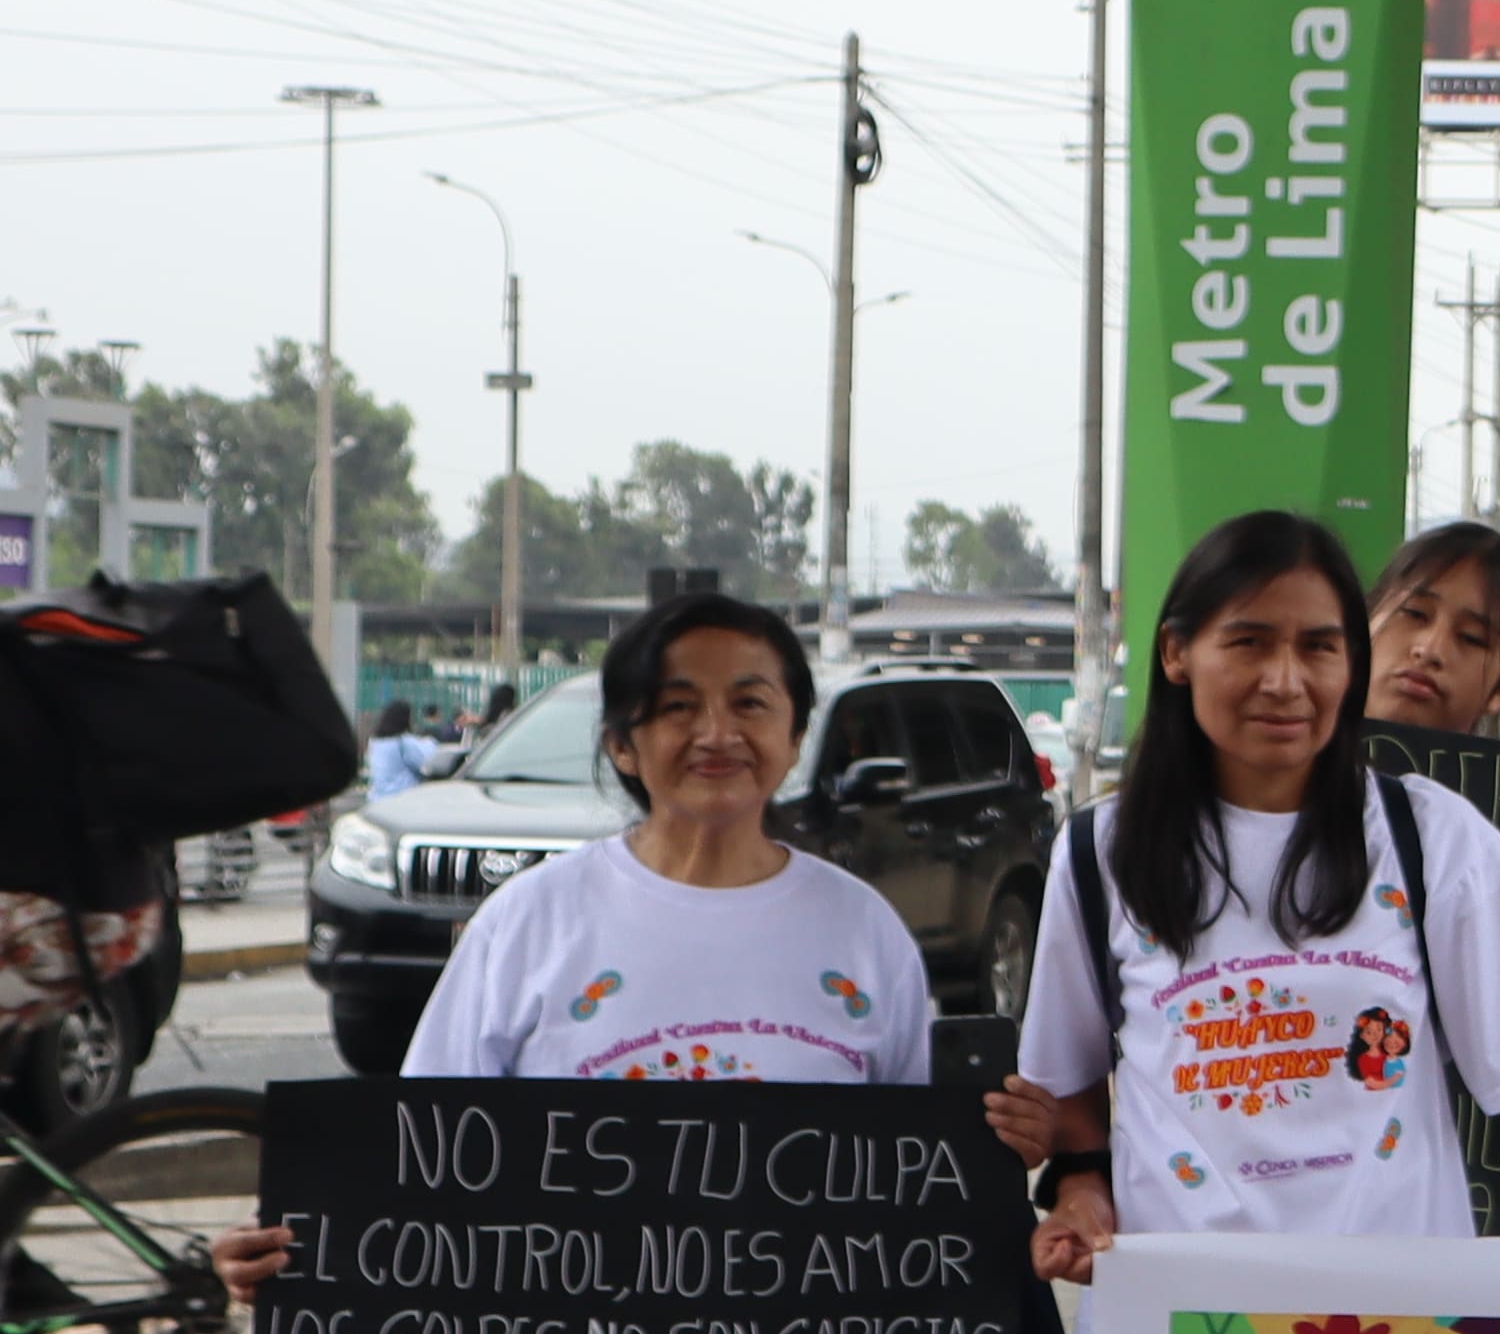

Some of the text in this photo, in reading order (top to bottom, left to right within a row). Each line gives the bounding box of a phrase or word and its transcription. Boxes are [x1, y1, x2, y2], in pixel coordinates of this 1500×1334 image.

[1170, 112, 1254, 423] Metro
[1261, 6, 1351, 427] de Lima
[276, 1212, 973, 1303] EL CONTROL, NO ES AMOR
[397, 1101, 969, 1208] NO ES TU CULPA
